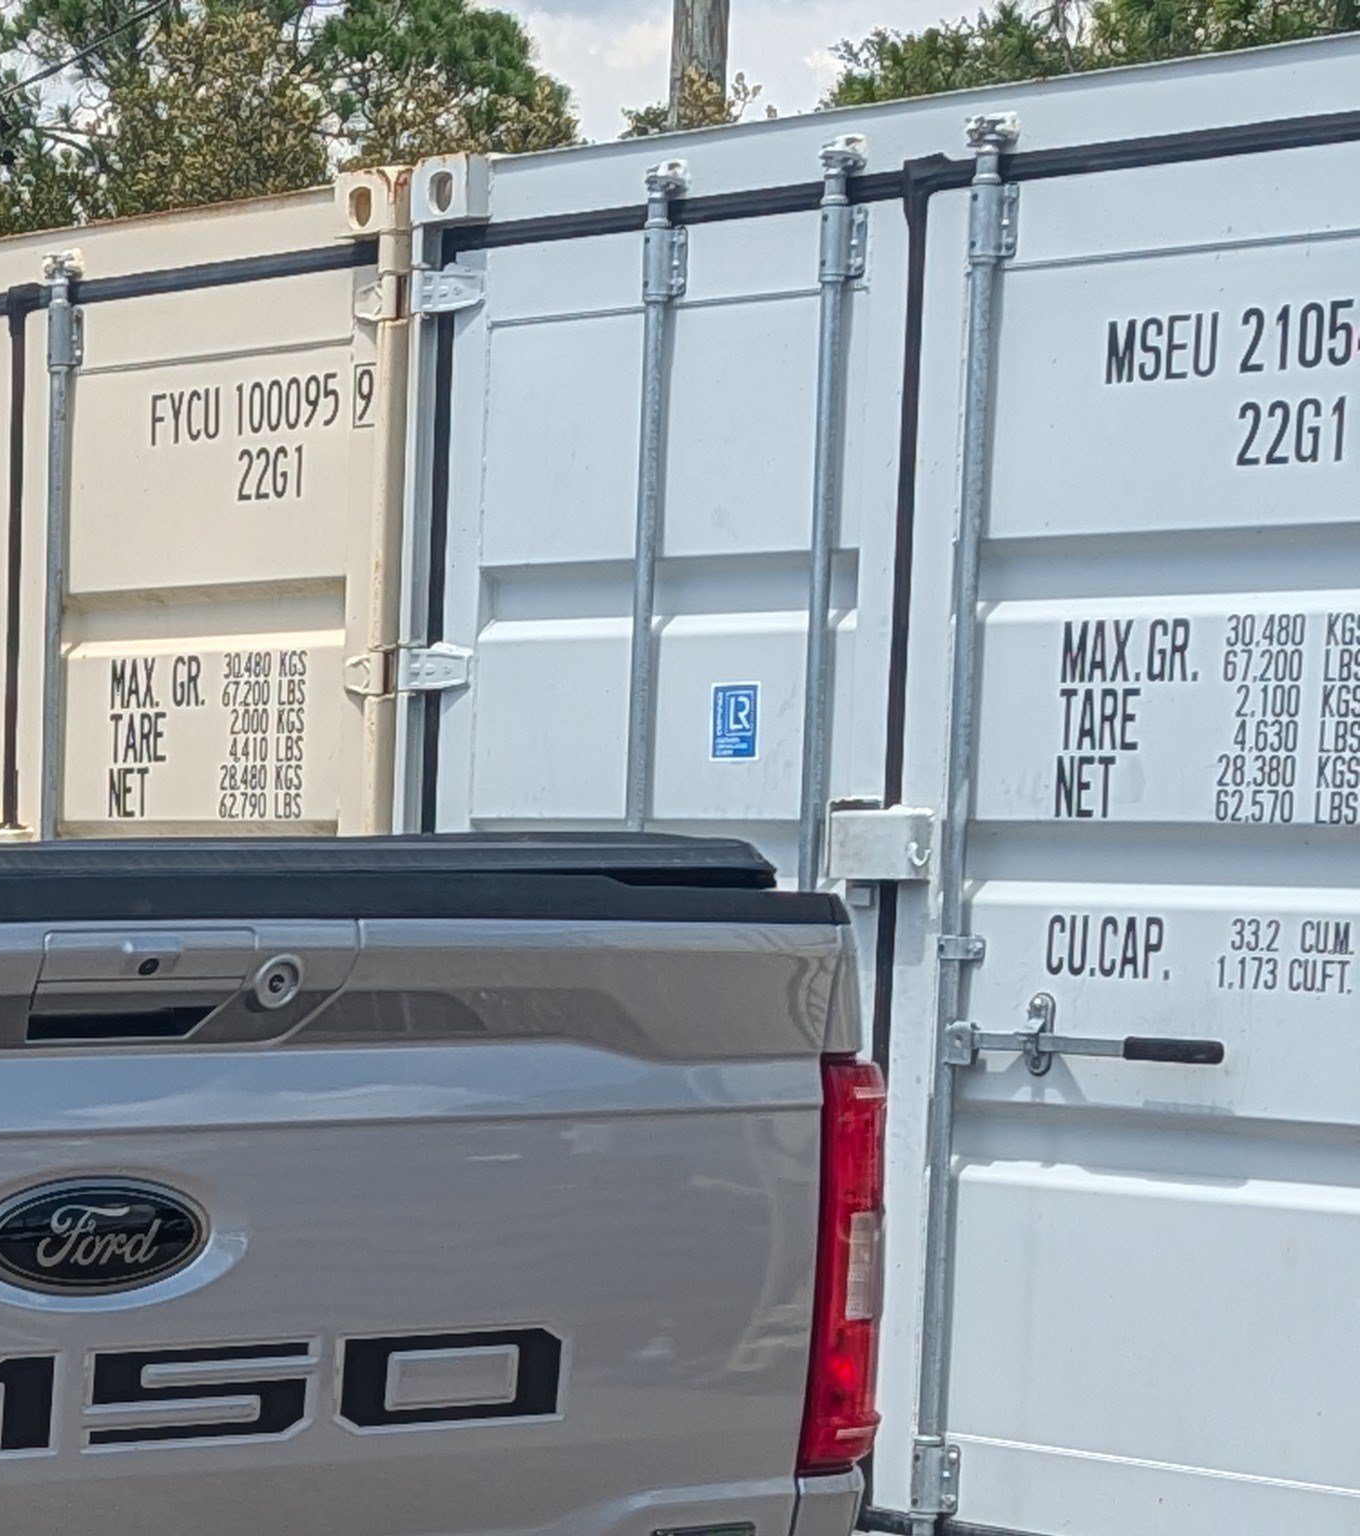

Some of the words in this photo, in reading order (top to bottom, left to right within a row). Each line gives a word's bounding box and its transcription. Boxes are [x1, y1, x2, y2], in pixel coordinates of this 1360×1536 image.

[1105, 311, 1220, 384] MSEU
[1238, 298, 1360, 374] 2105
[149, 387, 221, 446] FYCU
[235, 372, 339, 437] 100095
[357, 368, 375, 422] 9
[1236, 395, 1347, 467] 22G1
[237, 444, 304, 501] 22G1
[278, 650, 308, 677] KGS
[110, 657, 160, 709] MAX.
[172, 655, 205, 707] GR.
[277, 679, 306, 706] LBS
[1320, 684, 1360, 718] KGS
[276, 707, 305, 734] KGS
[1059, 687, 1141, 751] TARE
[109, 712, 167, 764] TARE
[275, 735, 304, 762] LBS
[1318, 720, 1360, 754] LBS
[274, 764, 303, 790] KGS
[1054, 755, 1116, 818] NET
[1316, 755, 1360, 789] KGS
[108, 767, 150, 818] NET
[273, 792, 302, 819] LBS
[1314, 790, 1358, 825] LBS
[1231, 918, 1281, 952] 33.2
[36, 1203, 163, 1268] Ford
